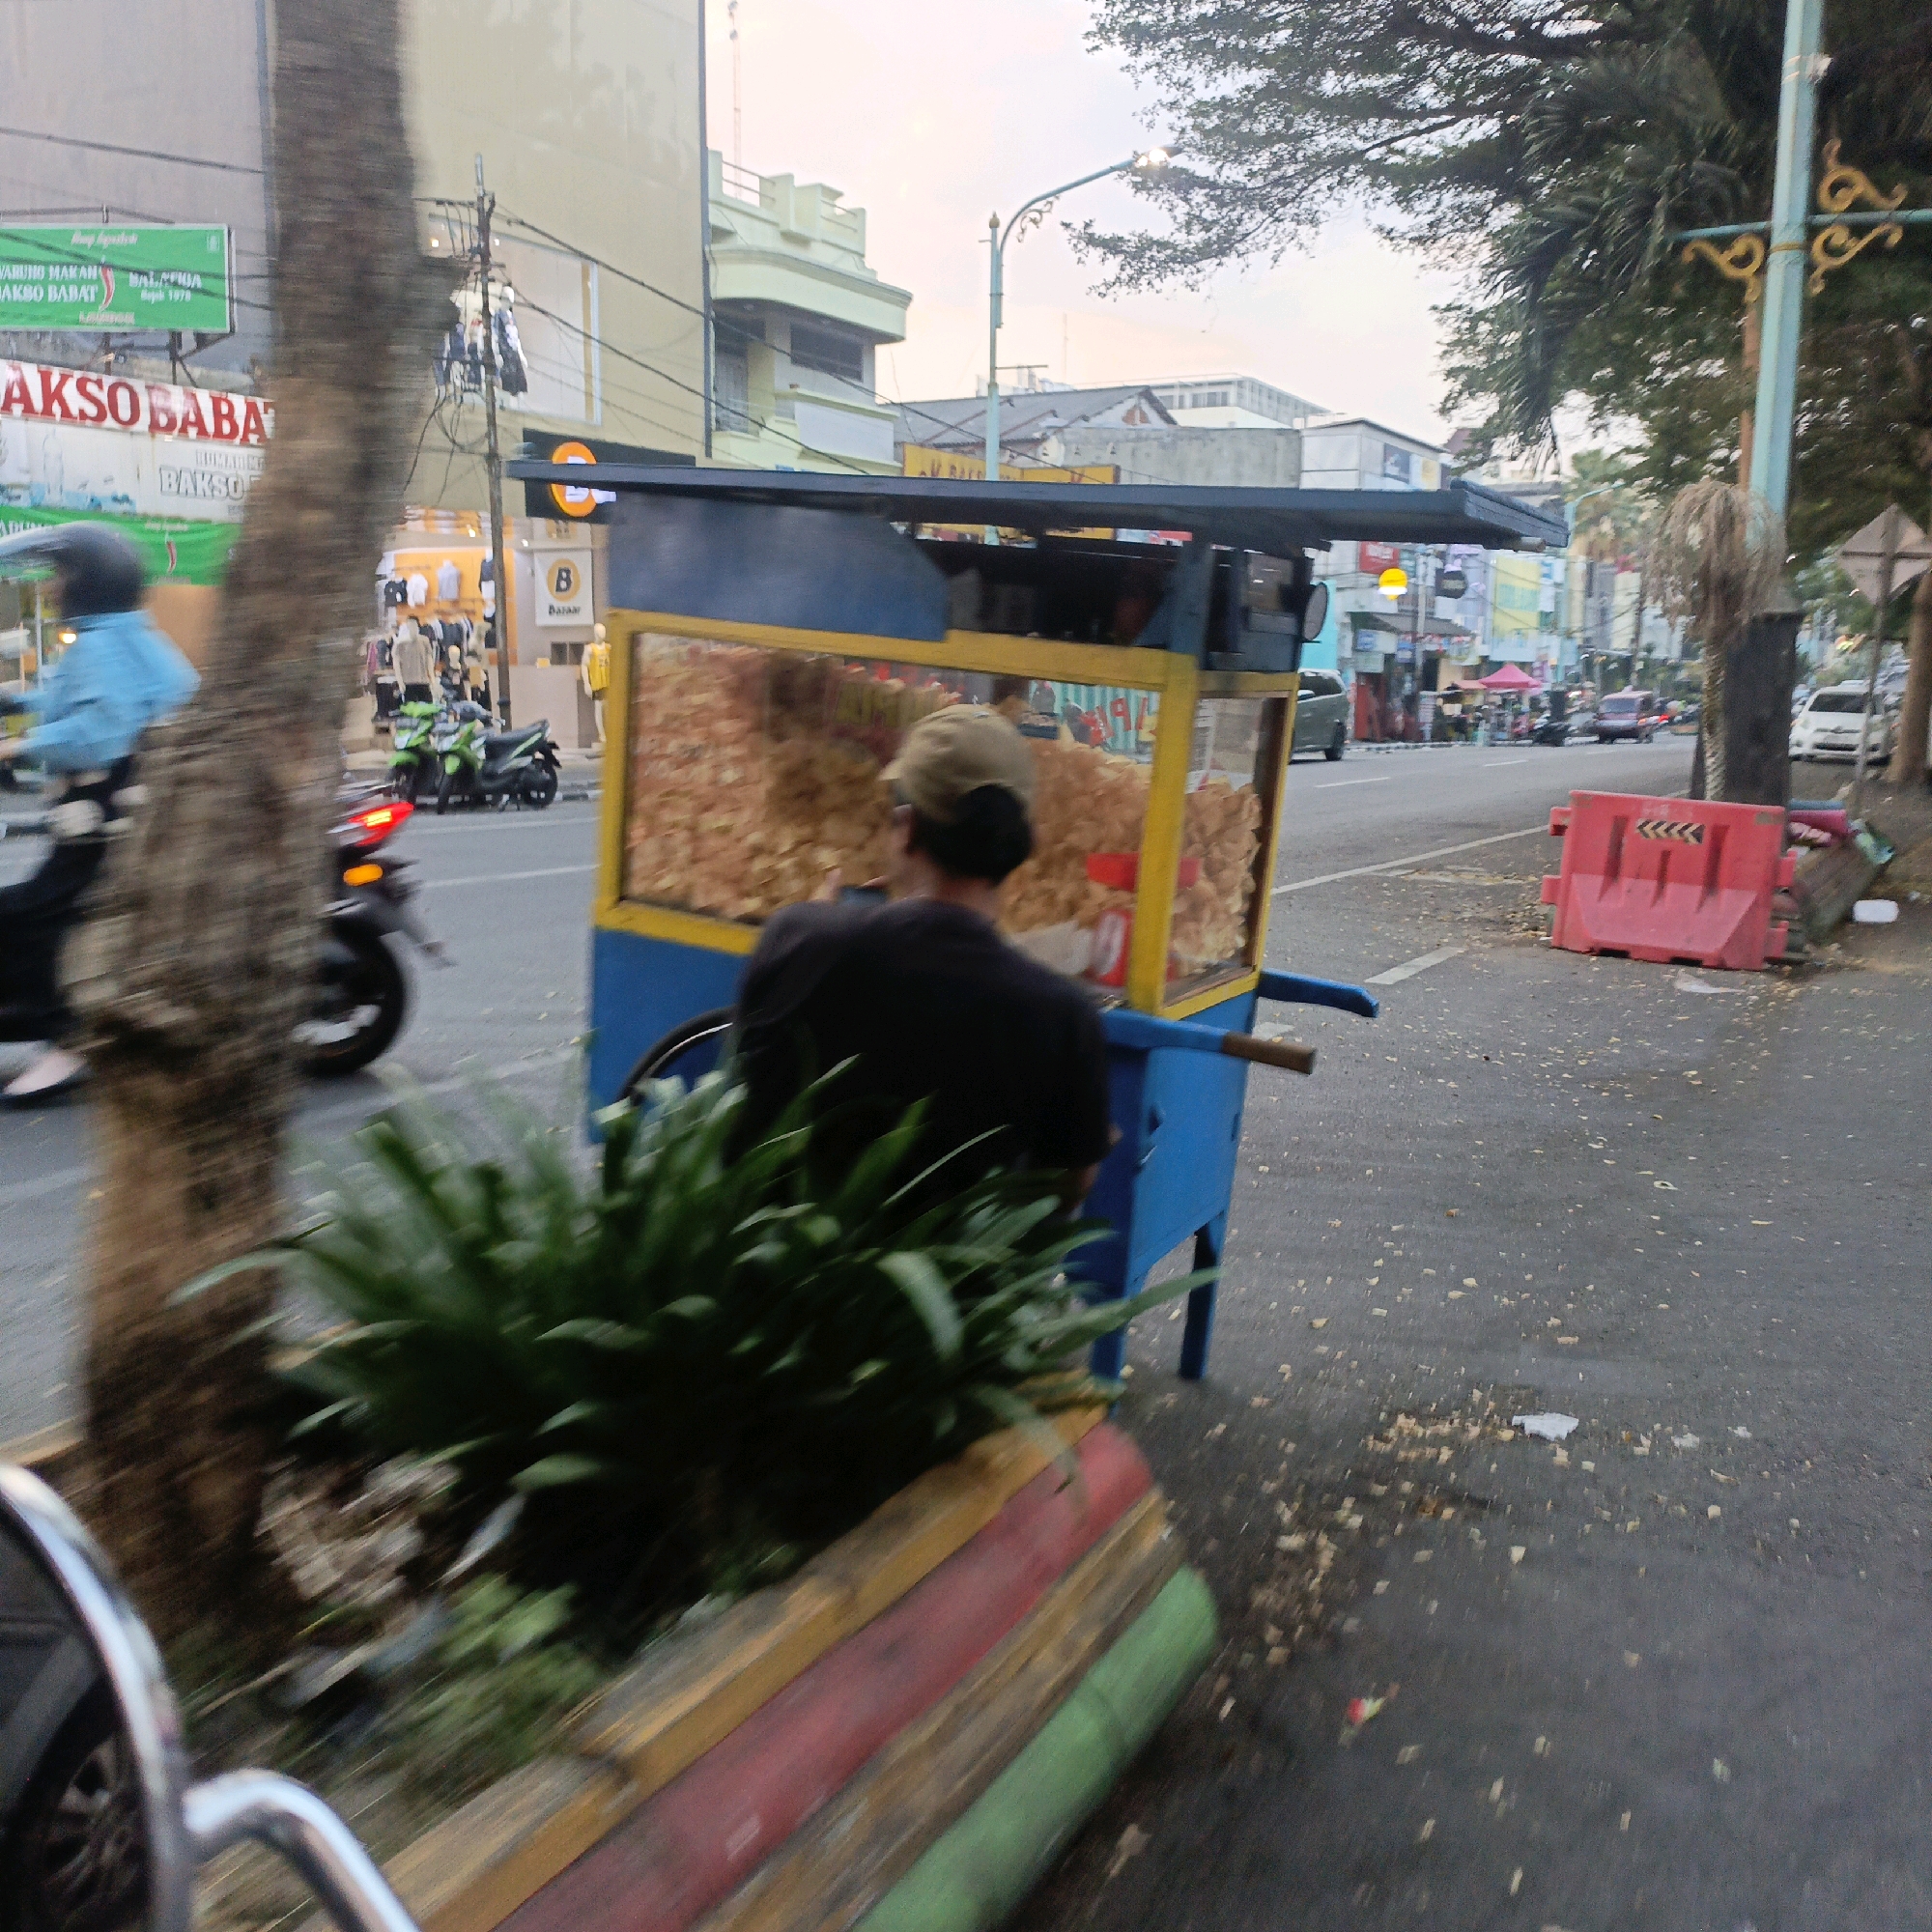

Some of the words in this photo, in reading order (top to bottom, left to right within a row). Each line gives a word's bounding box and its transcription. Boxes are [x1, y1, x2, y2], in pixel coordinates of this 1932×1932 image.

[0, 284, 44, 302] AKSO
[159, 465, 244, 501] BAKSO
[555, 567, 573, 593] B
[548, 604, 582, 616] Bazaar
